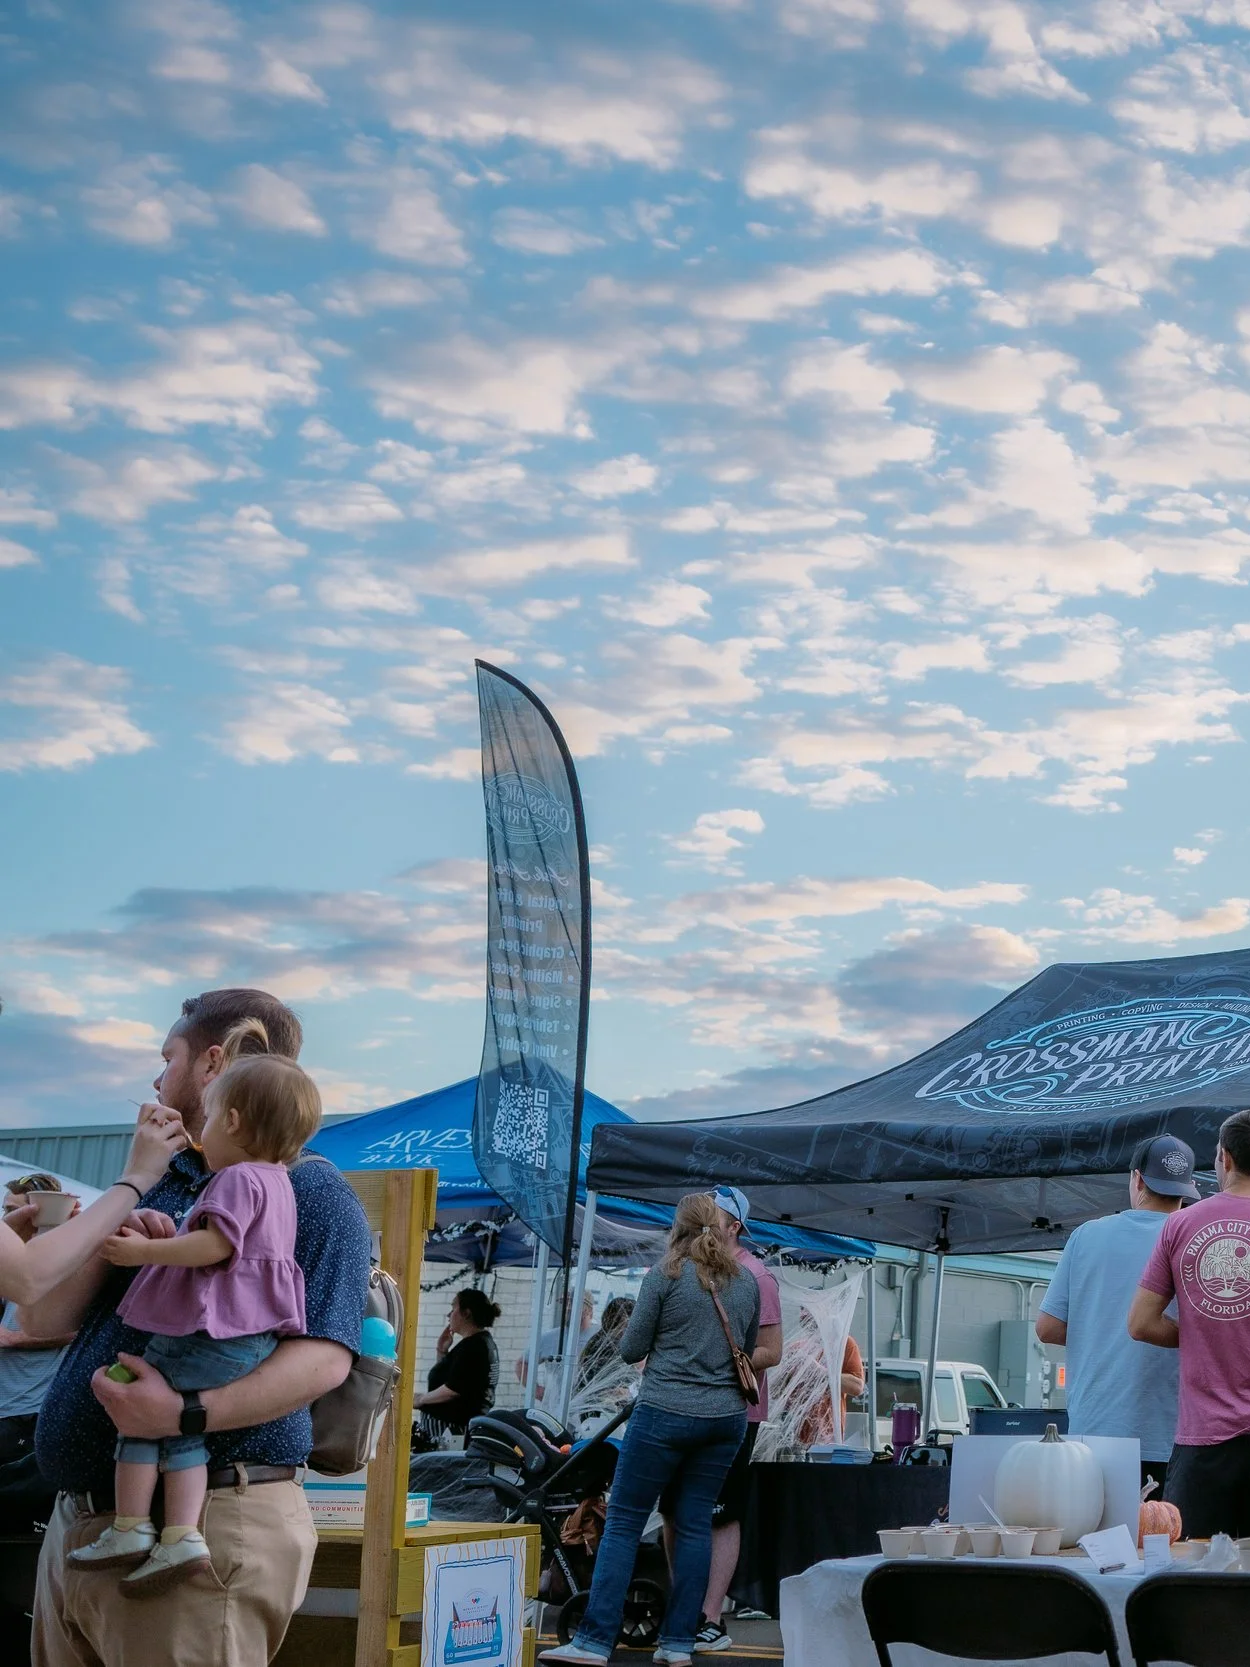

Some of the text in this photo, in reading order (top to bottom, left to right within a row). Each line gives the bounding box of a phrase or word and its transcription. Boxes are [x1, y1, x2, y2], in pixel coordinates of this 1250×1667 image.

[1056, 1012, 1106, 1030] PRINTING
[1121, 1003, 1164, 1016] COPYING
[914, 1020, 1194, 1099] CROSSMAN
[366, 1128, 473, 1153] ARVES
[358, 1153, 442, 1165] BANK
[1186, 1222, 1225, 1257] PANAMA
